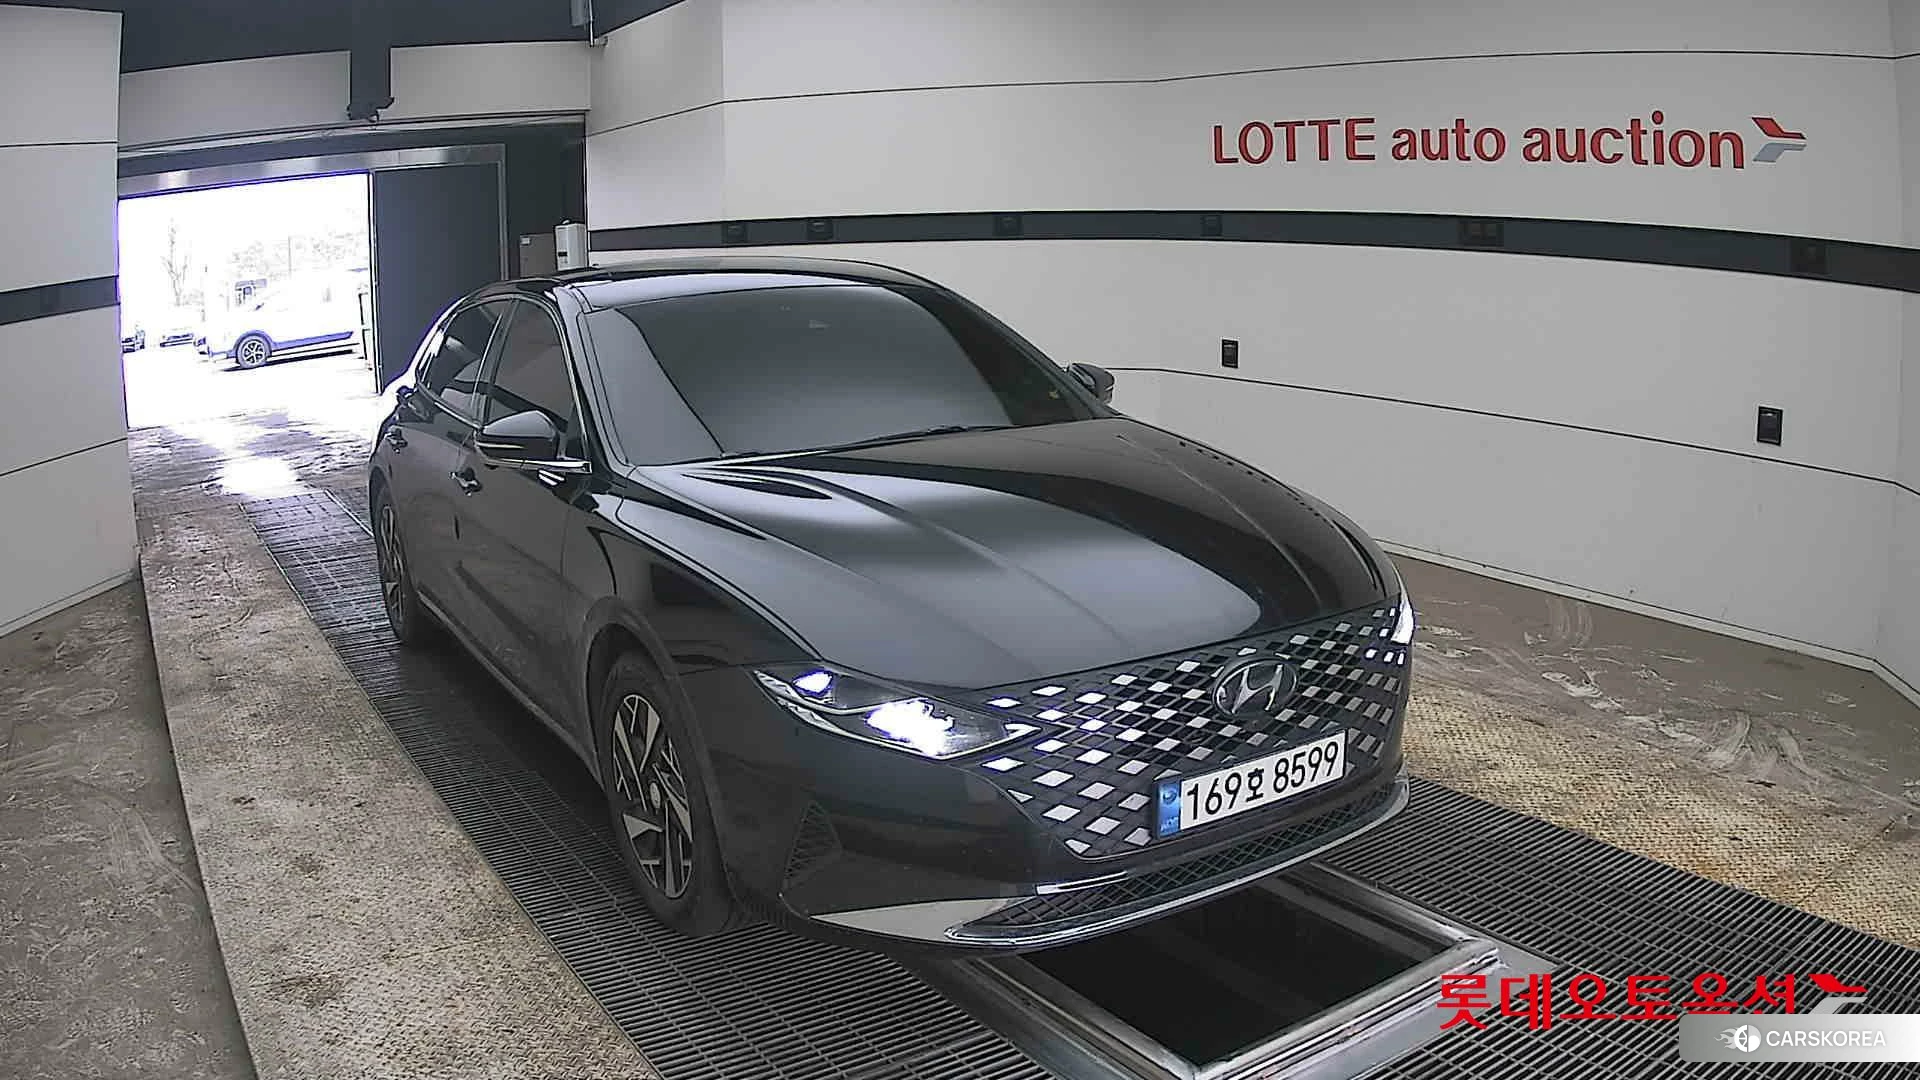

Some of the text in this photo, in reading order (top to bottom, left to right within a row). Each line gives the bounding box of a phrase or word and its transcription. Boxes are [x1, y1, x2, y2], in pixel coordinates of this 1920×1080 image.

[1213, 110, 1745, 169] LOTTE auto auction
[1186, 741, 1339, 821] 169호 8599
